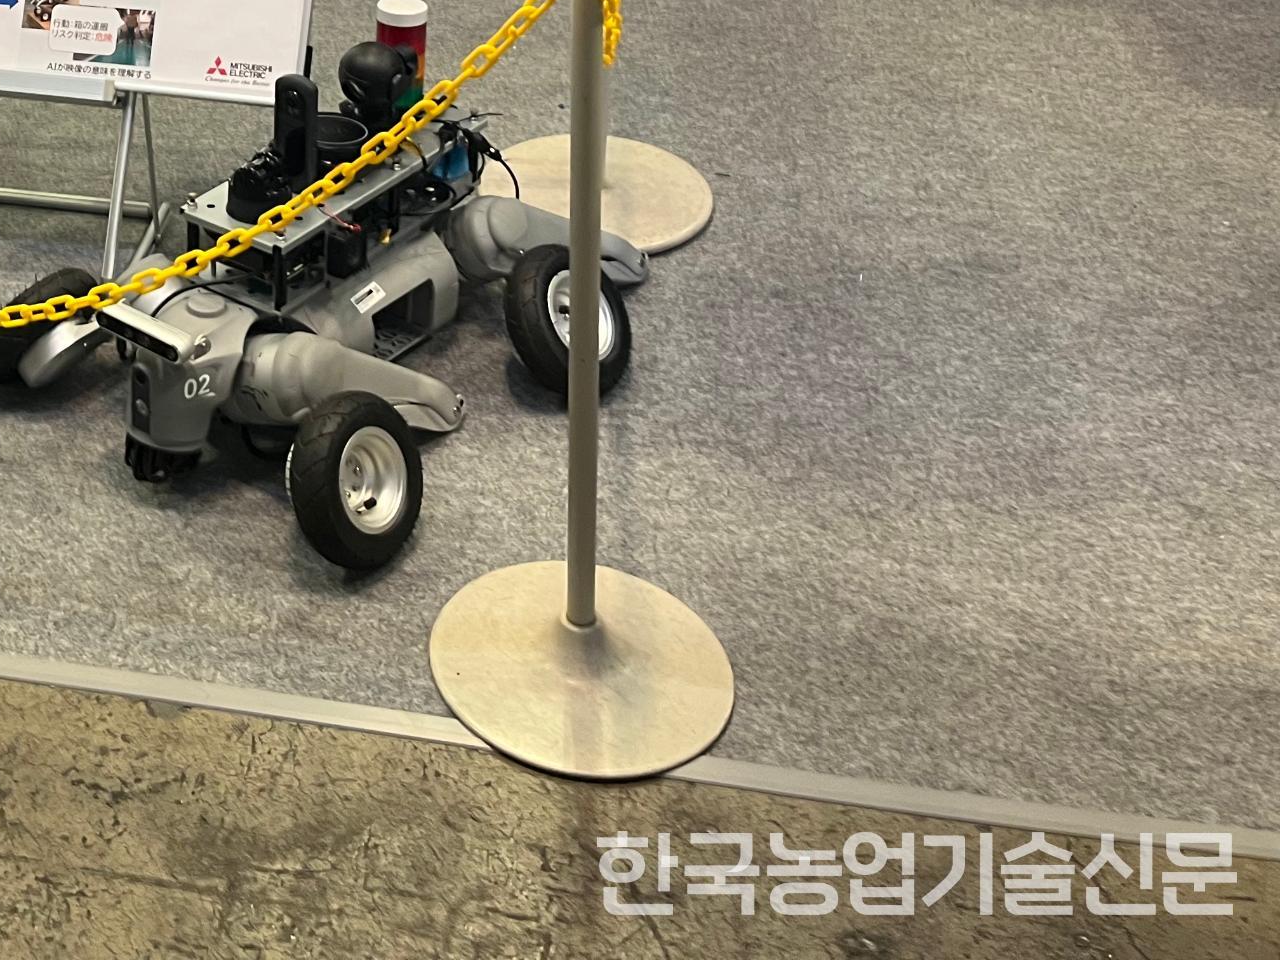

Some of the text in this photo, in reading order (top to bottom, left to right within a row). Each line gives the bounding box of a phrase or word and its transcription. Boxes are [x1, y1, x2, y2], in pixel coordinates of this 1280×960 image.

[46, 62, 152, 80] AIが映像の意味を理解する
[229, 62, 273, 73] MITSUBISHI
[229, 69, 266, 79] ELECTRIC
